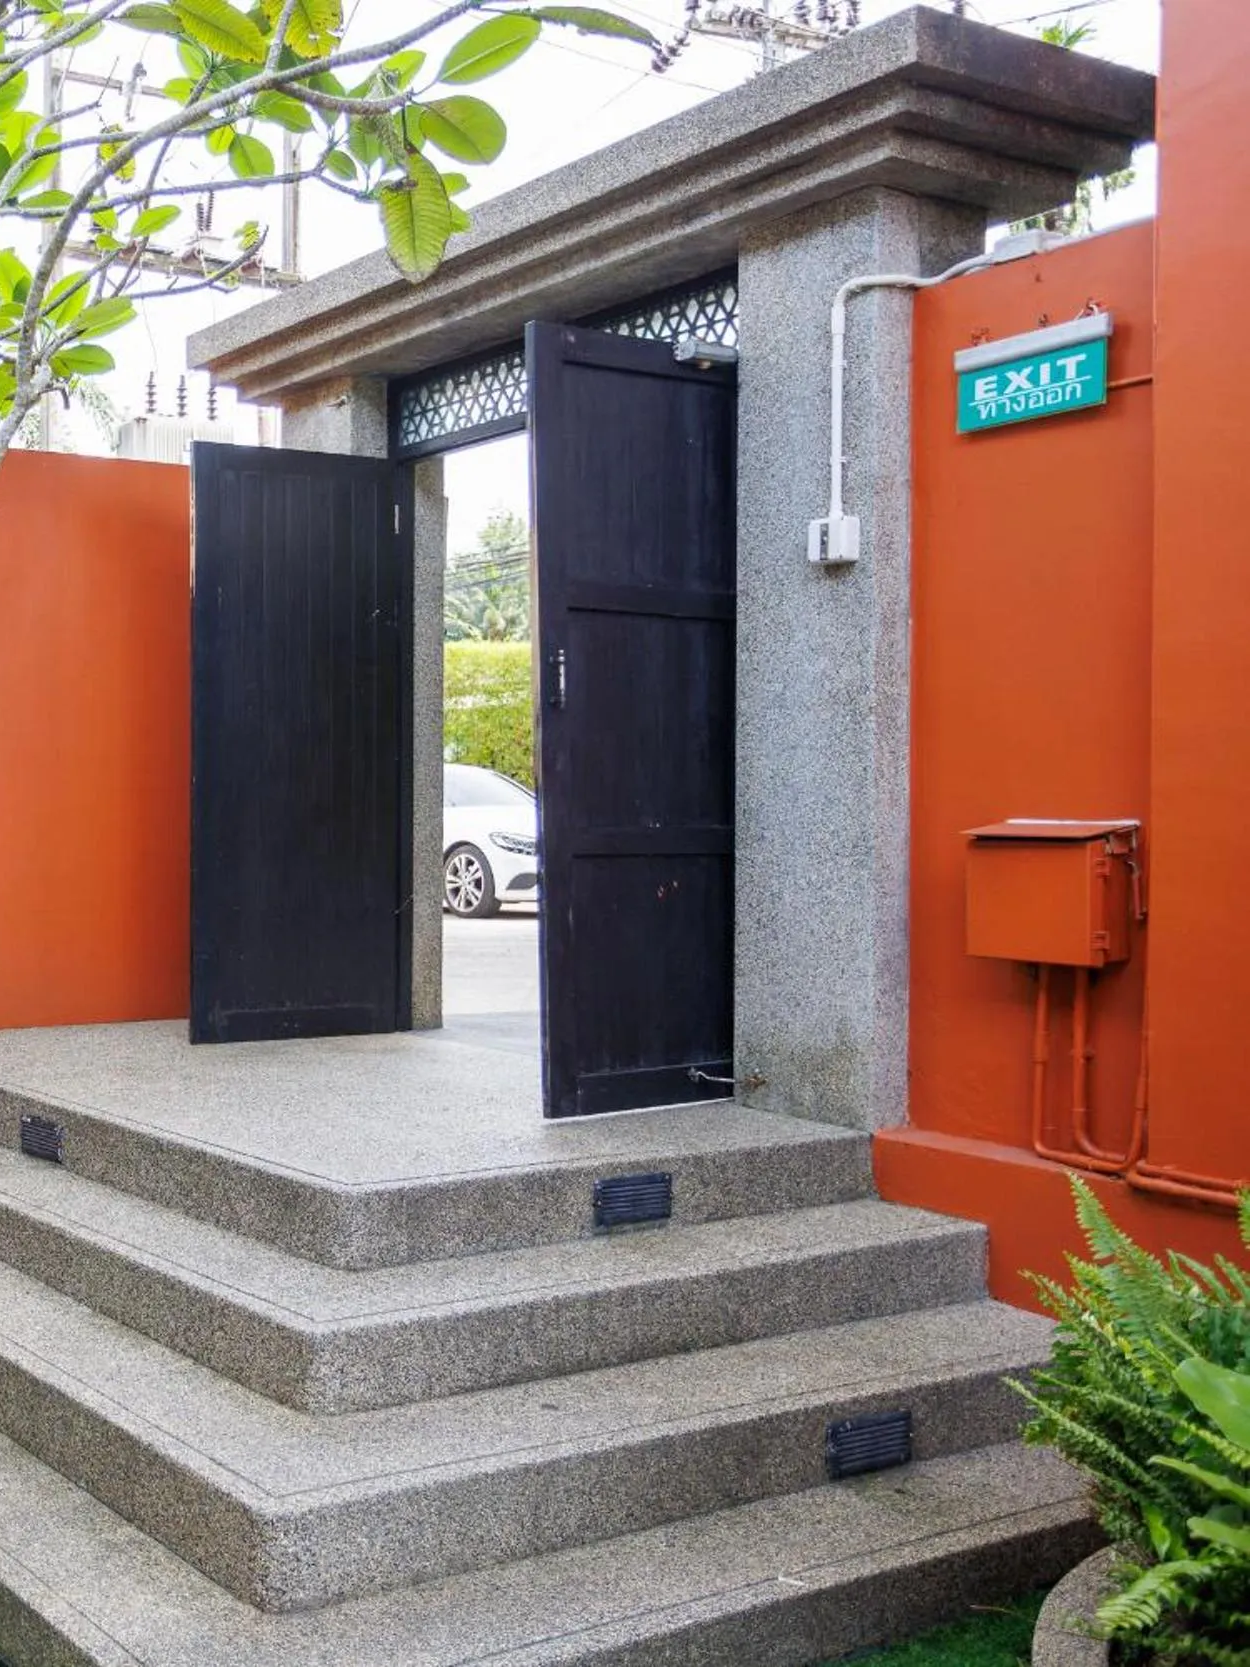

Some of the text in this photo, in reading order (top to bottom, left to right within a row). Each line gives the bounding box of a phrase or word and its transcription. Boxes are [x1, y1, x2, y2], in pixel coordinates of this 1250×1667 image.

[974, 353, 1087, 400] EXIT
[977, 382, 1083, 420] ทางออก
